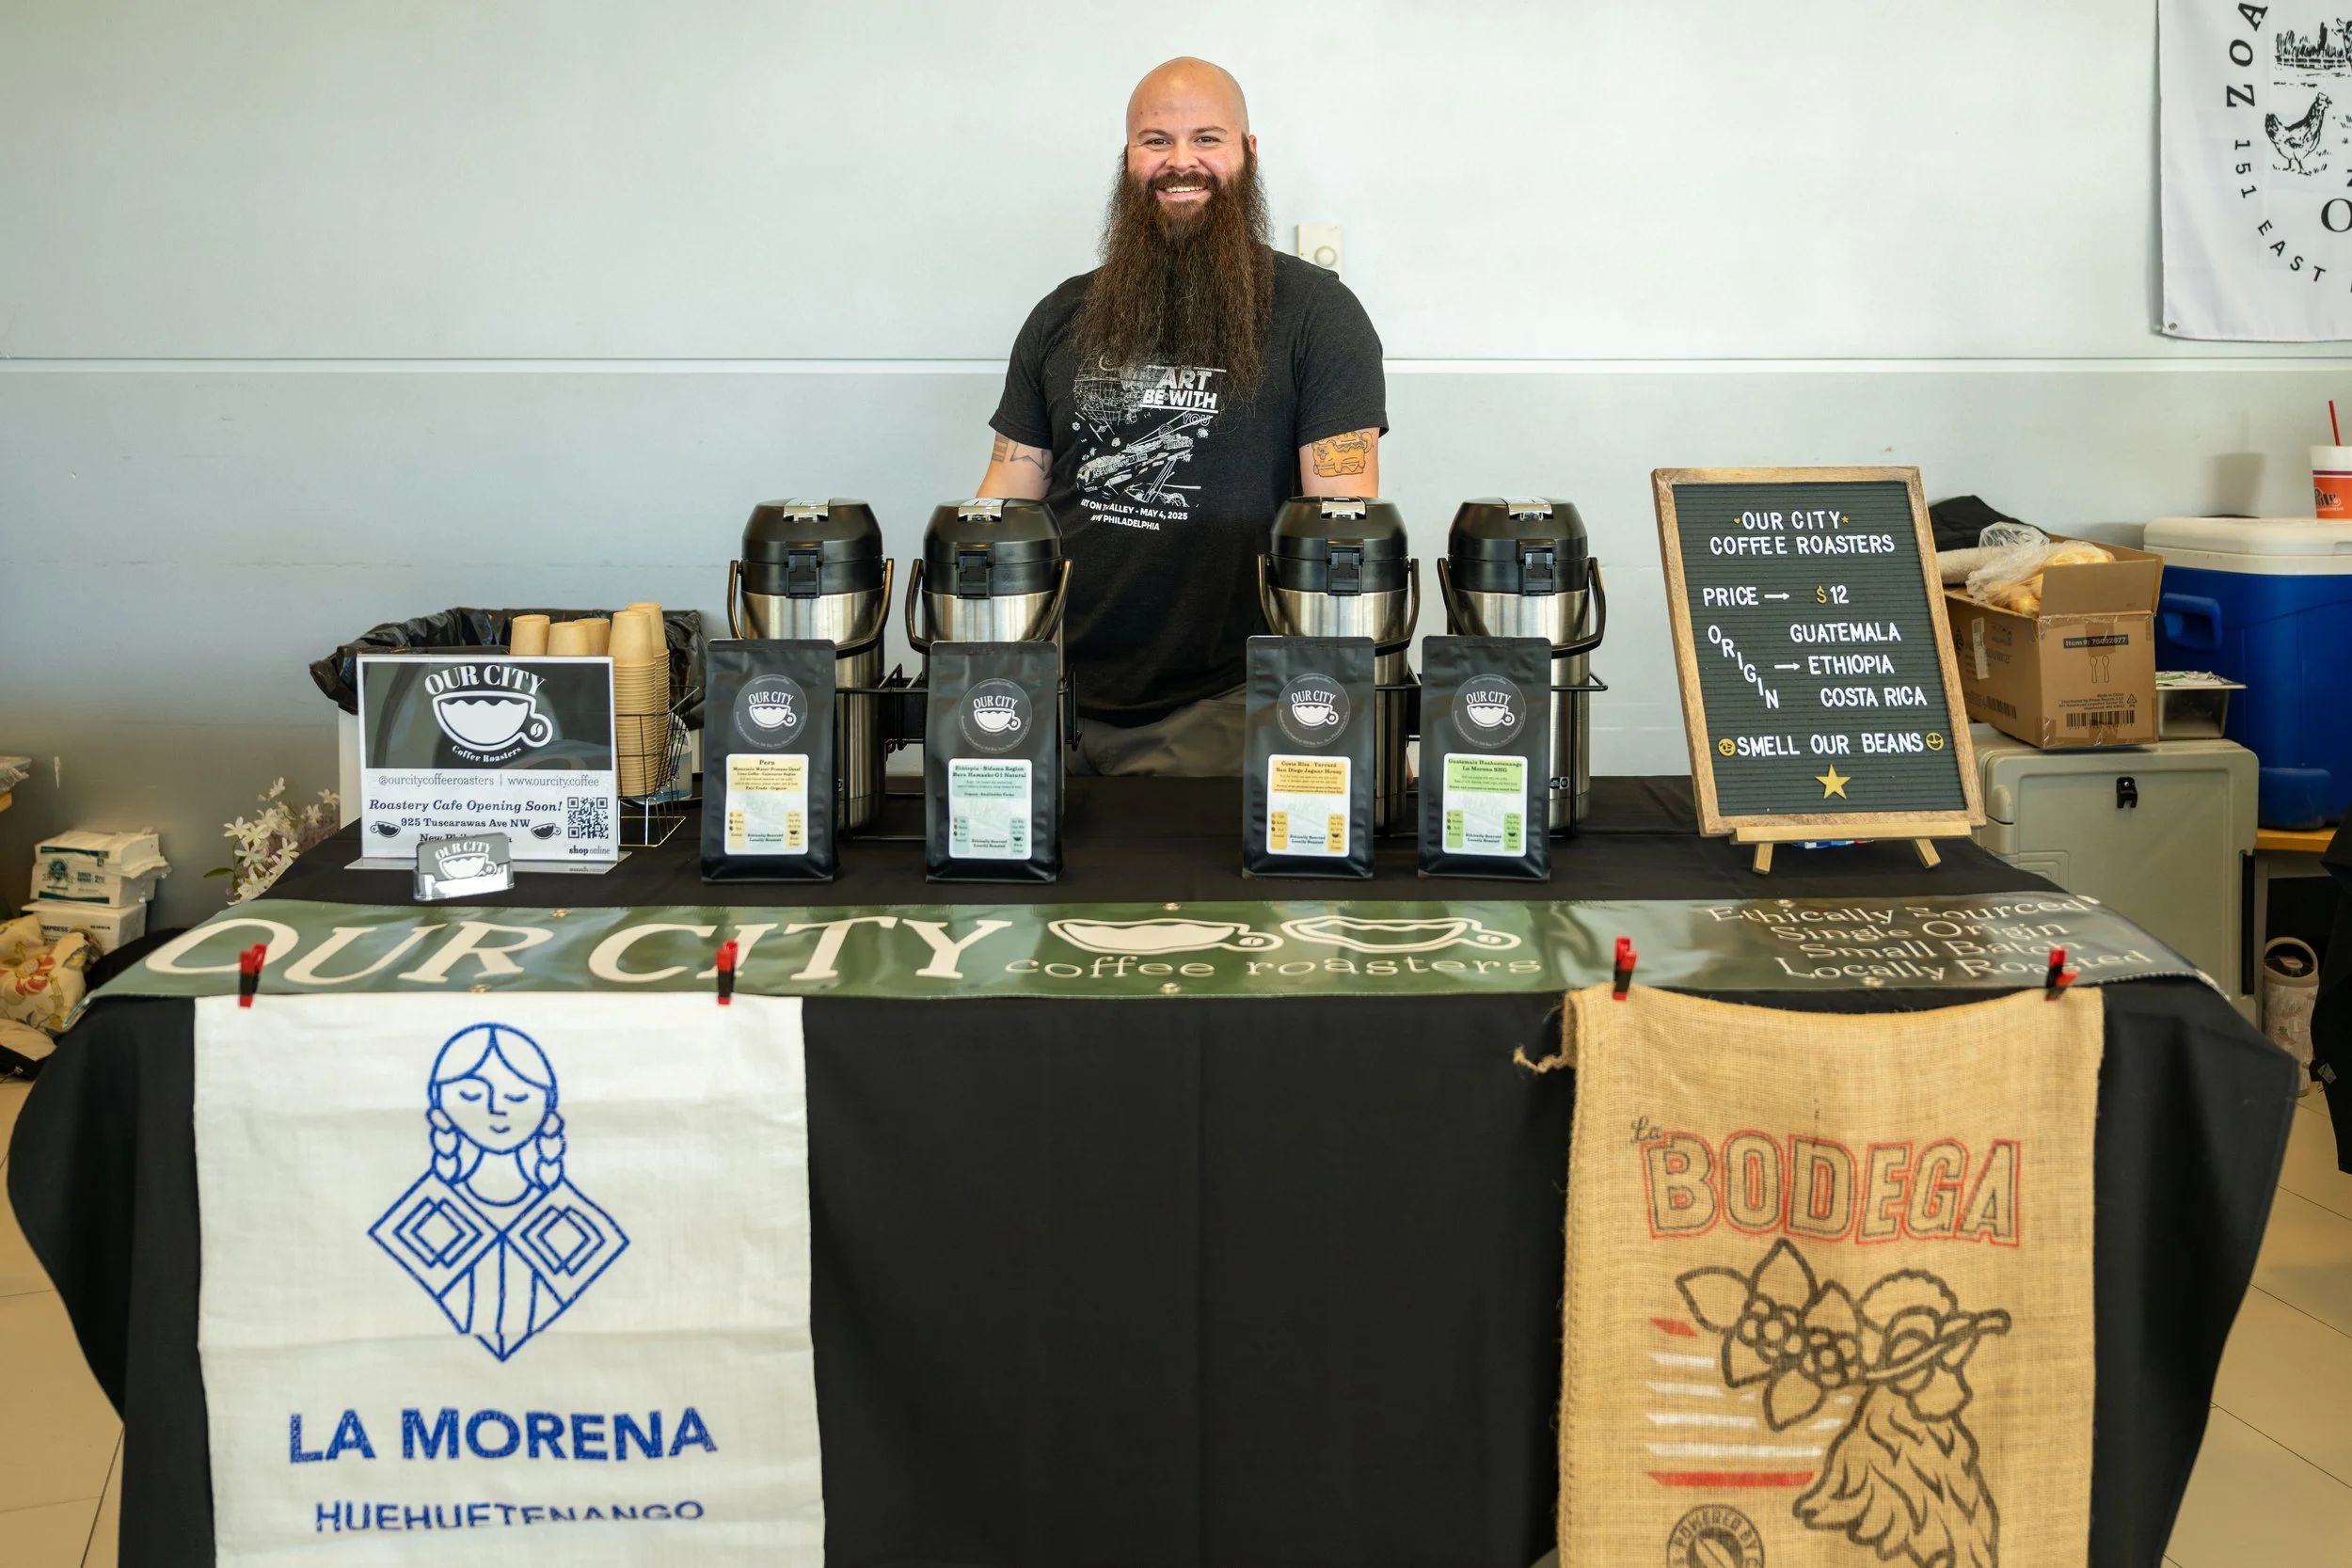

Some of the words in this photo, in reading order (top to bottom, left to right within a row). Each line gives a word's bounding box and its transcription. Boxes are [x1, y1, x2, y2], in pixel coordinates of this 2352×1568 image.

[2257, 219, 2327, 283] EAST
[1156, 368, 1213, 390] ART
[1143, 388, 1166, 405] BE
[1169, 389, 1217, 409] WITH
[1183, 413, 1211, 427] YOU
[1089, 500, 1102, 511] ON
[1139, 507, 1158, 517] MAY
[1168, 511, 1188, 520] 2025
[1103, 515, 1160, 531] PHILADELPHIA
[1741, 512, 1783, 531] OUR
[1791, 511, 1841, 530] CITY
[1708, 535, 1788, 556] COFFEE
[1797, 534, 1896, 555] ROASTERS
[1703, 586, 1759, 607] PRICE
[1789, 622, 1902, 643] GUATEMALA
[1708, 625, 1780, 709] ORIGIN
[1807, 655, 1895, 675] ETHIOPIA
[424, 665, 480, 696] OUR
[484, 664, 548, 695] CITY
[748, 691, 770, 705] OUR
[771, 691, 794, 705] CITY
[974, 695, 993, 708] OUR
[994, 695, 1018, 709] CITY
[1291, 689, 1312, 704] OUR
[1313, 689, 1336, 704] CITY
[1466, 690, 1487, 705] OUR
[1488, 690, 1511, 705] CITY
[1820, 687, 1879, 707] COSTA
[1883, 686, 1928, 706] RICA
[452, 745, 481, 763] Coffee
[483, 746, 522, 763] Roasters
[1737, 736, 1801, 757] SMELL
[1810, 735, 1850, 755] OUR
[1862, 733, 1924, 753] BEANS
[378, 773, 494, 786] @ourcitycoffeeroasters
[508, 774, 599, 788] www.ourcity.coffee
[369, 800, 429, 812] Roastery
[433, 800, 463, 811] Cafe
[467, 801, 522, 815] Opening
[525, 800, 563, 812] Soon!
[401, 818, 421, 828] 925
[422, 818, 486, 828] Tuscarawas
[488, 818, 508, 828] Ave
[510, 818, 531, 828] NW
[435, 843, 462, 860] OUR
[463, 842, 493, 854] CITY
[569, 845, 589, 856] shop
[590, 845, 610, 854] online
[1707, 905, 1894, 928] Ethically
[1904, 897, 2090, 922] Sourced
[1770, 924, 1914, 943] Single
[1921, 919, 2072, 941] Origin
[145, 918, 554, 985] OUR
[588, 915, 1013, 983] CITY
[1798, 940, 1939, 960] Small
[1943, 938, 2085, 958] Batch
[1005, 956, 1216, 978] coffee
[1245, 954, 1542, 977] roasters
[1774, 956, 1946, 982] Locally
[1954, 949, 2154, 977] Roasted
[1629, 1115, 1663, 1145] La
[1641, 1130, 2021, 1248] BODEGA
[289, 1408, 376, 1465] LA
[400, 1406, 719, 1462] MORENA
[315, 1499, 705, 1533] HUEHUETENANGO
[1672, 1509, 1741, 1548] POWERED
